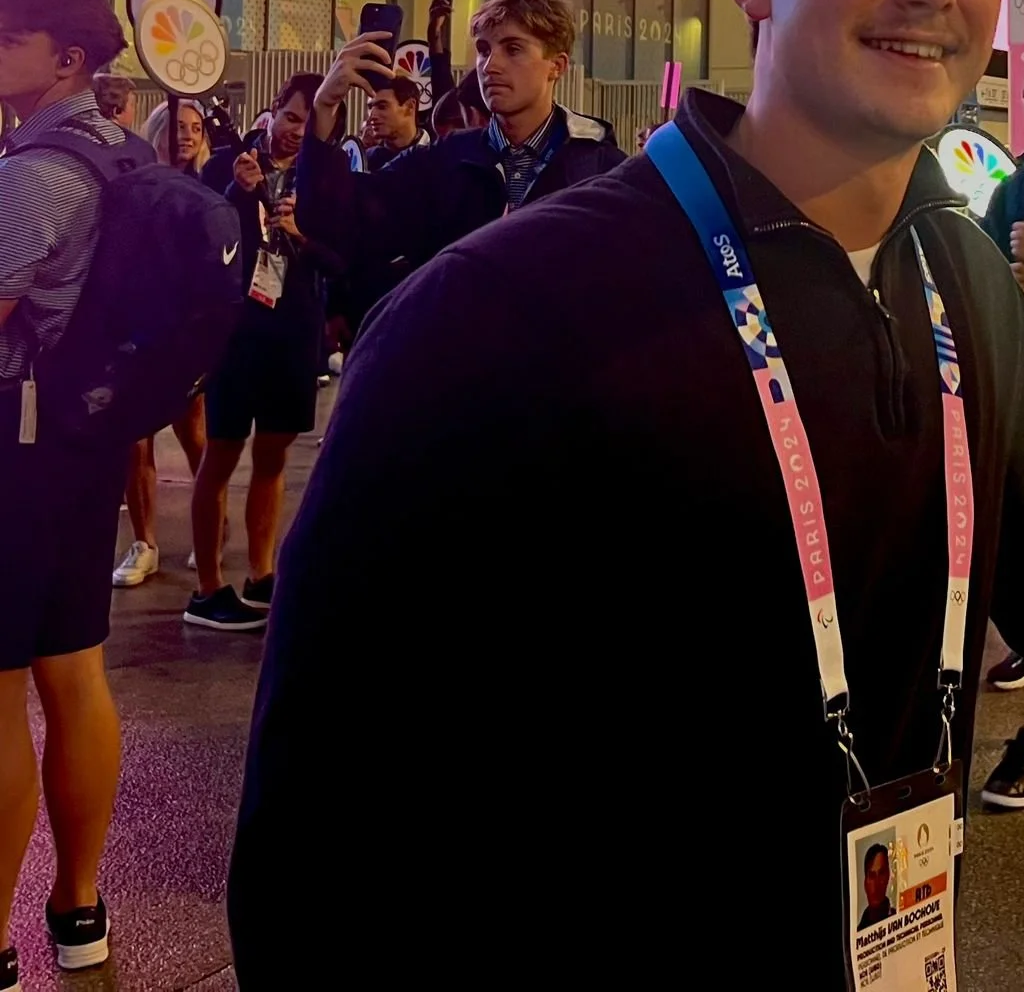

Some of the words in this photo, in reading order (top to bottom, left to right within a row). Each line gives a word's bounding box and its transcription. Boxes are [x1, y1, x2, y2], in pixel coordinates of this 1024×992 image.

[580, 9, 633, 39] PARIS
[714, 234, 743, 278] Atos
[779, 417, 809, 490] 2024
[951, 409, 965, 484] PARIS
[800, 500, 825, 585] PARIS
[954, 495, 967, 565] 2024
[887, 920, 903, 936] VAN
[903, 900, 940, 926] BOCHOVE
